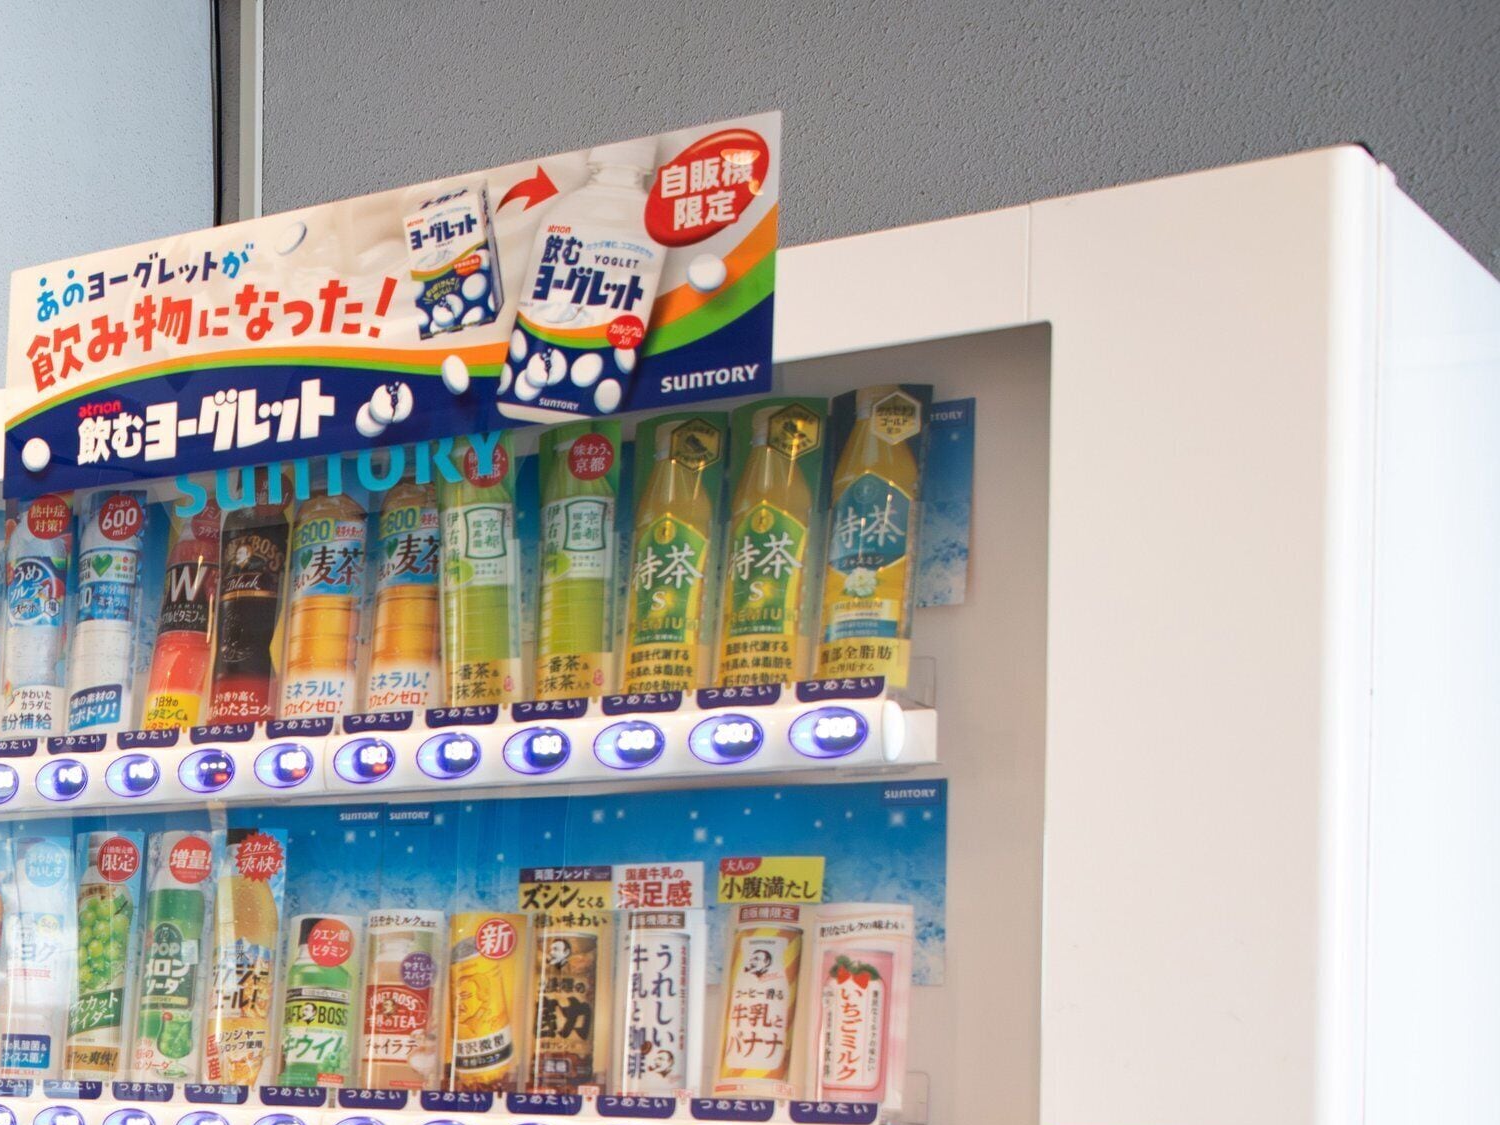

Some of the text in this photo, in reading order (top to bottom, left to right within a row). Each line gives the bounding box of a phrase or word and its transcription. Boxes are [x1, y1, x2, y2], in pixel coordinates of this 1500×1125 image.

[660, 155, 755, 200] 自販機
[672, 190, 738, 232] 限定
[410, 213, 478, 251] ヨーグレット
[541, 234, 584, 267] 飲む
[593, 255, 640, 269] YOGLET
[36, 242, 255, 323] あのヨーグレットが
[533, 265, 644, 311] ヨーグレット
[26, 277, 398, 393] 飲み物になった!
[660, 363, 760, 393] SUNTORY
[538, 396, 580, 411] SUNTORY
[77, 378, 336, 466] 飲むヨーグレット
[573, 456, 606, 474] 京都
[30, 503, 67, 520] 熱中症
[101, 507, 139, 530] 600
[33, 518, 63, 533] 対策!
[833, 502, 907, 550] 特茶
[309, 545, 366, 587] 麦茶
[632, 542, 705, 592] 特茶
[728, 532, 803, 582] 特茶
[883, 788, 936, 800] SUNTORY
[339, 812, 379, 821] SUNTORY
[389, 811, 430, 820] SUNTORY
[102, 855, 134, 872] 限定
[170, 848, 213, 871] 増量!
[240, 855, 282, 874] 爽快!
[723, 858, 756, 872] 大人の
[625, 866, 684, 881] 国産牛乳の
[521, 883, 605, 910] ズシンとくる
[617, 881, 693, 910] 満足感
[720, 875, 819, 899] 小腹満たし
[740, 905, 799, 922] 自販機限定
[312, 945, 348, 958] ビタミン
[480, 924, 512, 955] 新
[652, 944, 677, 1045] うれしい
[318, 1006, 348, 1027] BOSS
[731, 1002, 784, 1028] 牛乳と
[727, 1031, 784, 1060] バナナ
[836, 988, 859, 1083] いちごミルク
